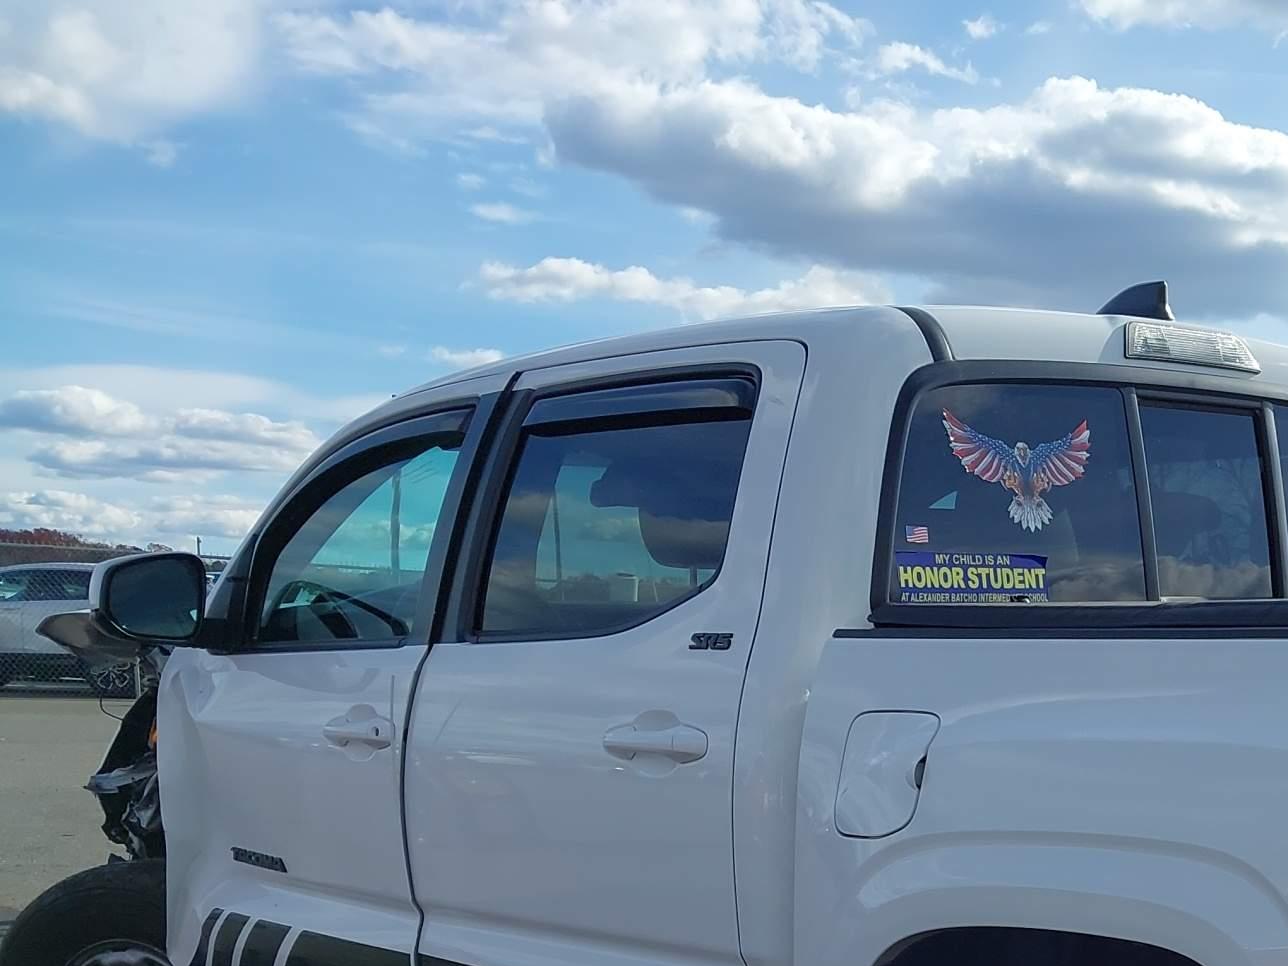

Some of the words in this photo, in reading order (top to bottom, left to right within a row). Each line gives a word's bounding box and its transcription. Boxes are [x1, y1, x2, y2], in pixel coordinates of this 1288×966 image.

[935, 554, 950, 565] MY
[953, 554, 983, 566] CHILD
[985, 555, 995, 566] IS
[997, 555, 1011, 566] AN
[899, 566, 966, 589] HONOR
[967, 567, 1046, 590] STUDENT
[901, 592, 910, 603] AT
[911, 592, 950, 603] ALEXANDER
